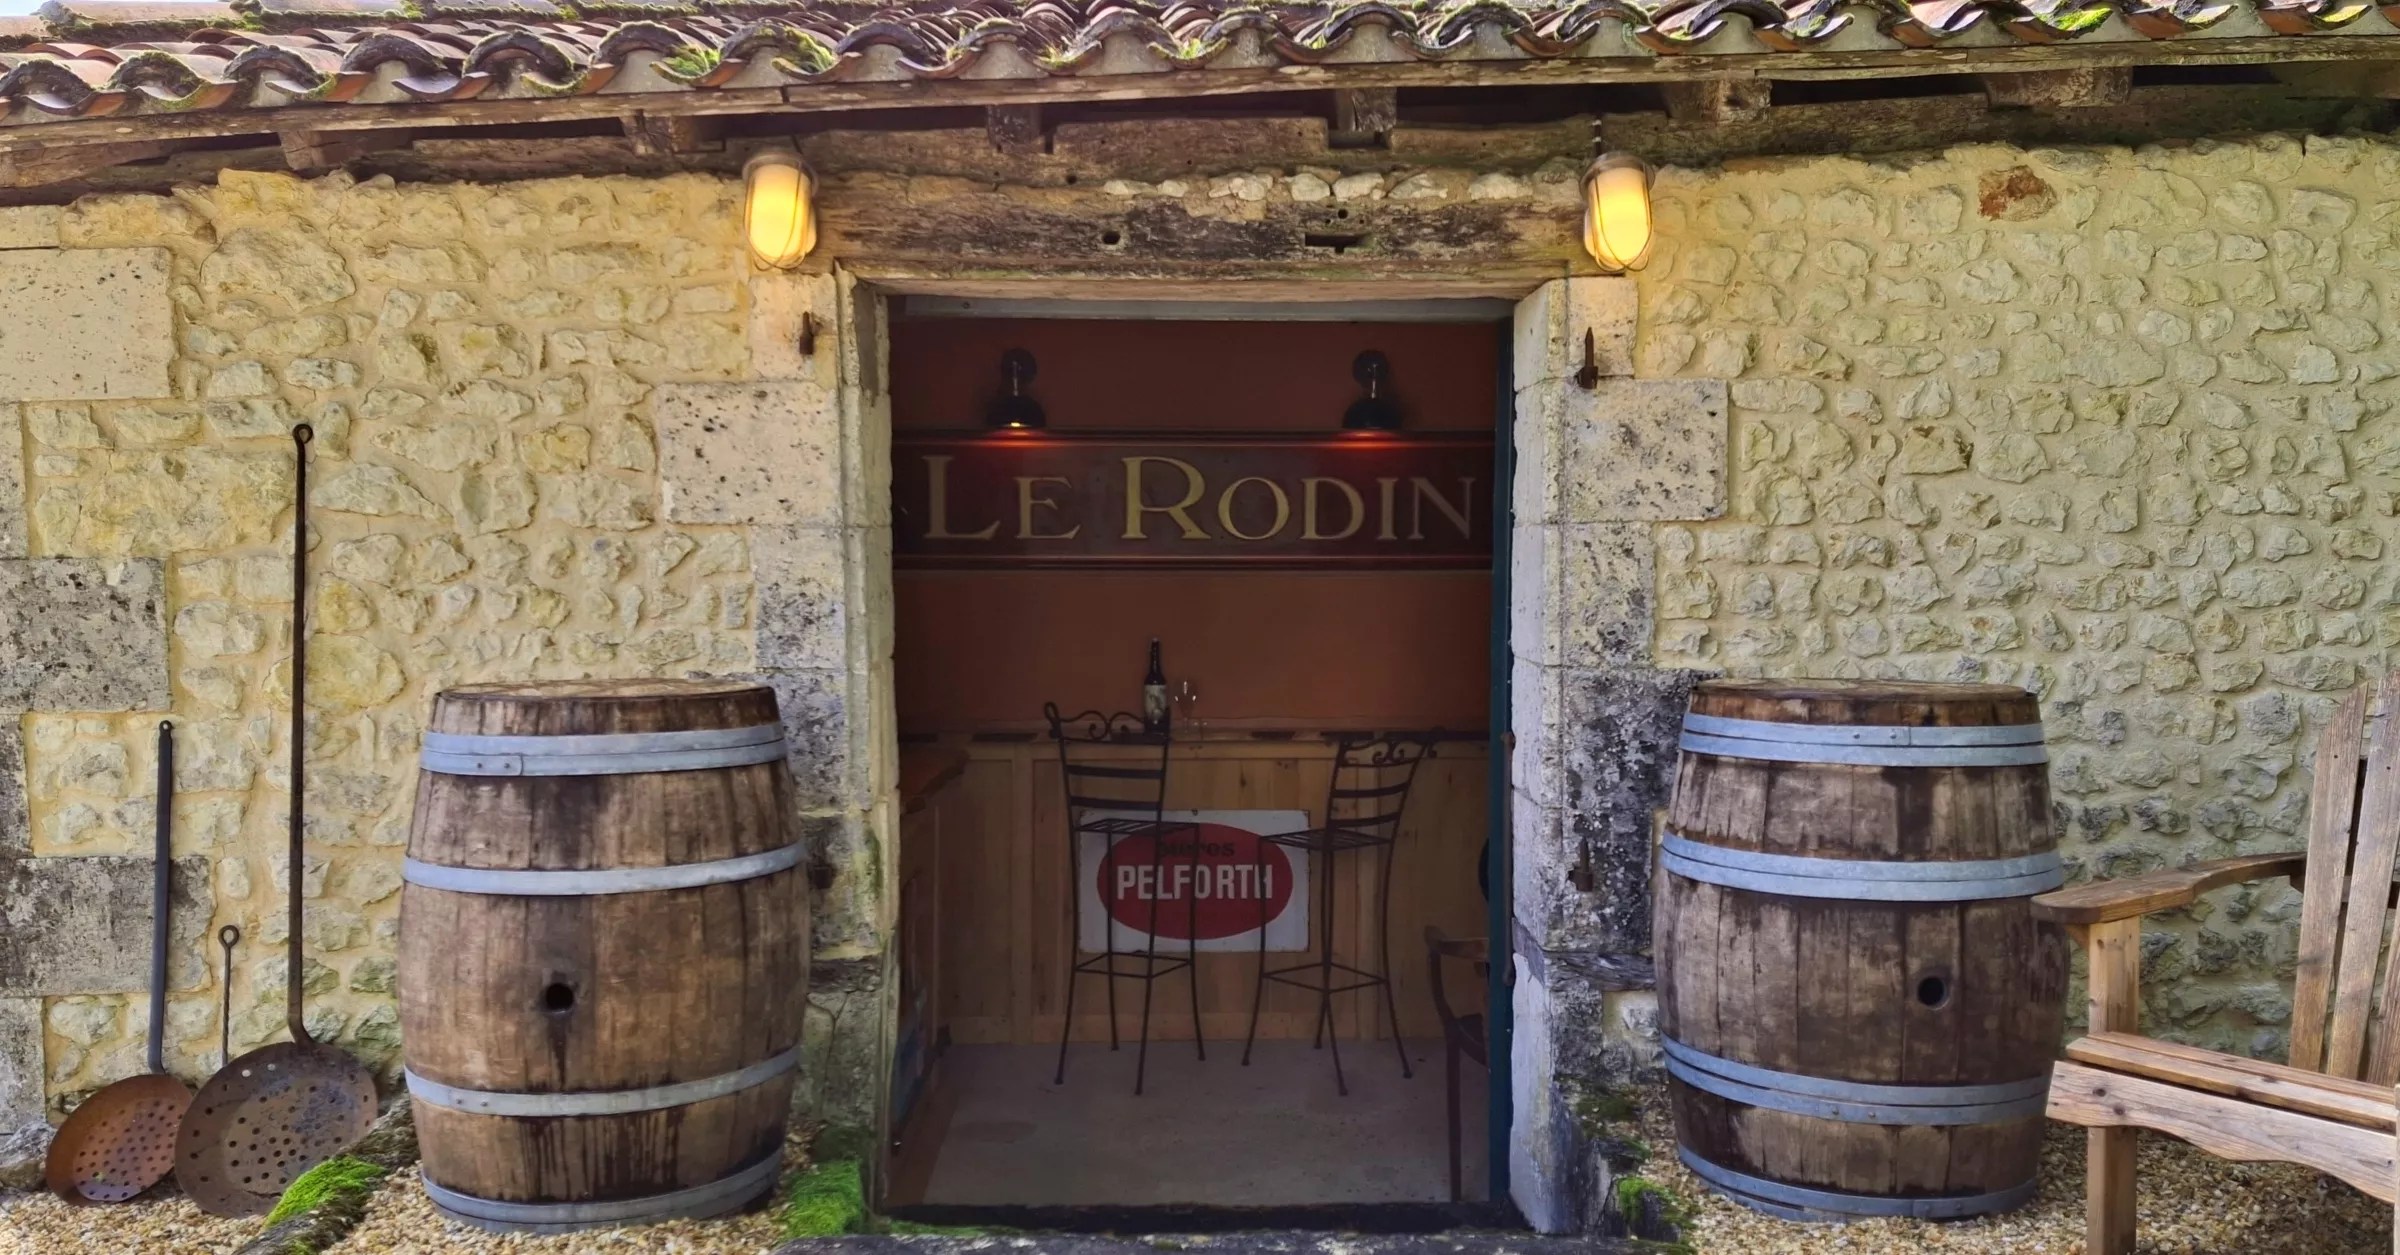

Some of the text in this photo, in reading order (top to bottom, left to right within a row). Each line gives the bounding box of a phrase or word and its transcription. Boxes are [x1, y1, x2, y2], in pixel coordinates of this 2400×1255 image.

[922, 455, 1476, 541] LE RODIN
[1117, 864, 1272, 900] PELFORTH
